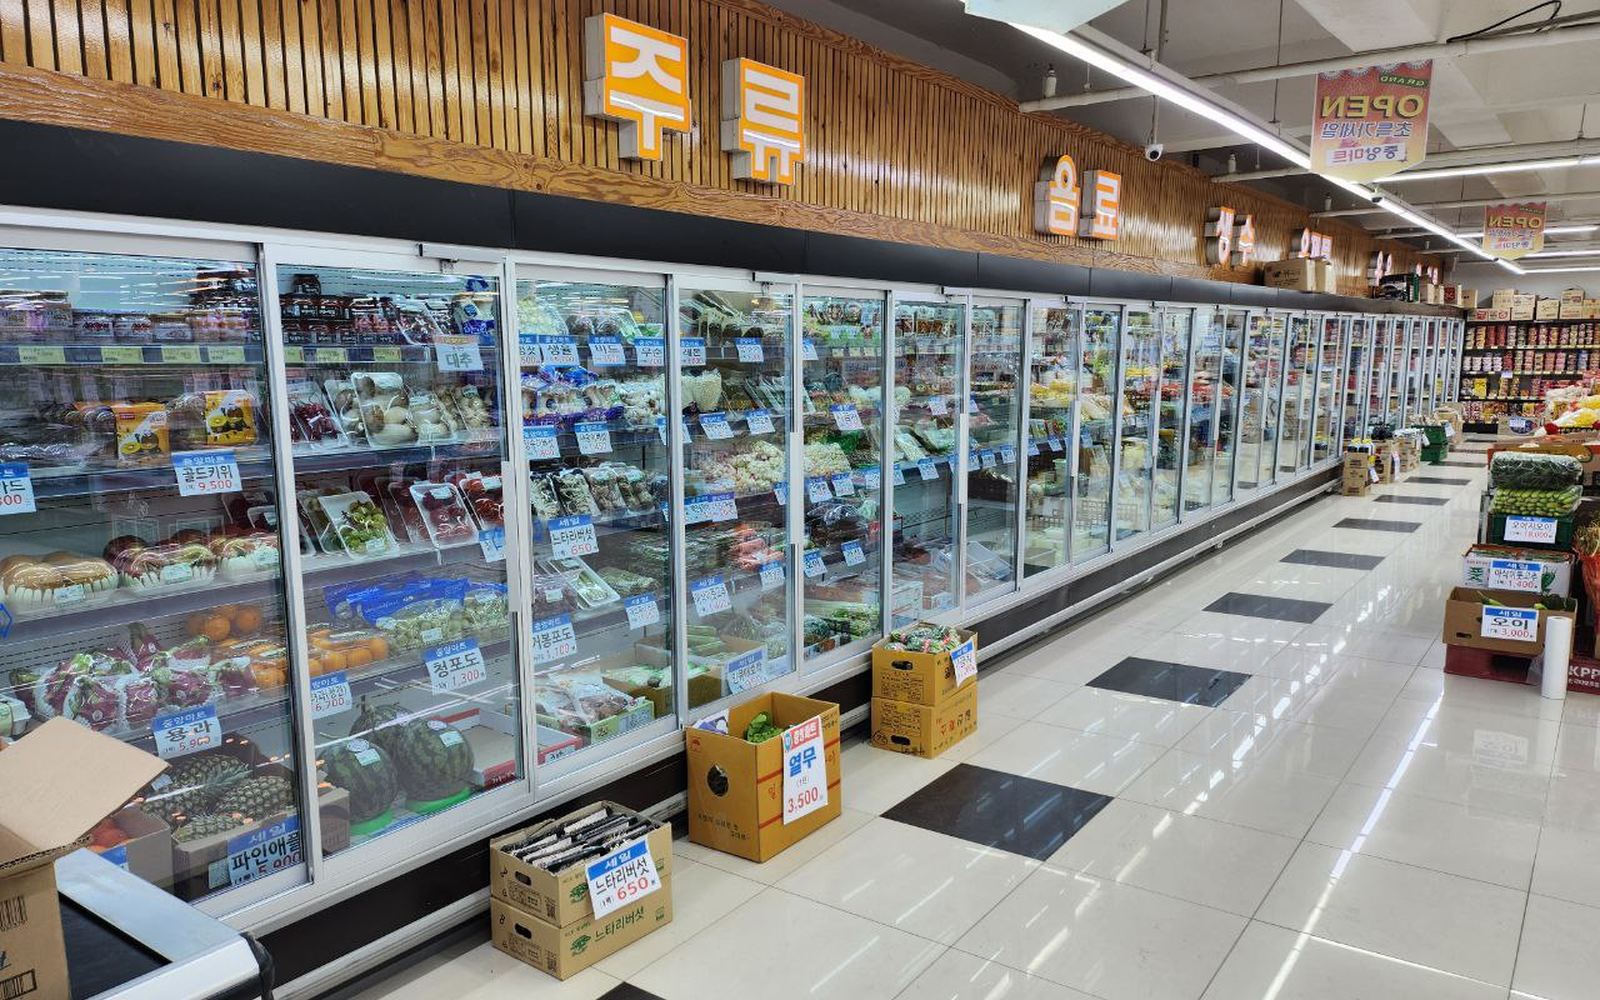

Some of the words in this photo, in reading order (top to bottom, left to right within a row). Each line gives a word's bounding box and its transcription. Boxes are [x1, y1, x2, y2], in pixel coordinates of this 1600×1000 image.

[608, 22, 802, 180] 주류
[1049, 157, 1121, 240] 음료
[445, 354, 473, 371] 대추
[183, 465, 233, 483] 골드키위
[552, 523, 594, 547] 느타리버섯
[570, 543, 592, 555] 650
[1491, 617, 1529, 630] 오이
[1498, 611, 1522, 619] 세일
[1500, 629, 1529, 639] 3,000
[433, 652, 480, 679] 청포도
[165, 720, 214, 743] 용과
[789, 746, 817, 777] 열무
[787, 786, 819, 814] 3,500
[249, 820, 287, 844] 세일
[232, 831, 303, 871] 파인애플
[604, 850, 632, 870] 세일
[595, 856, 649, 896] 느타리버섯
[617, 876, 649, 900] 650
[594, 906, 644, 942] 느타리버섯
